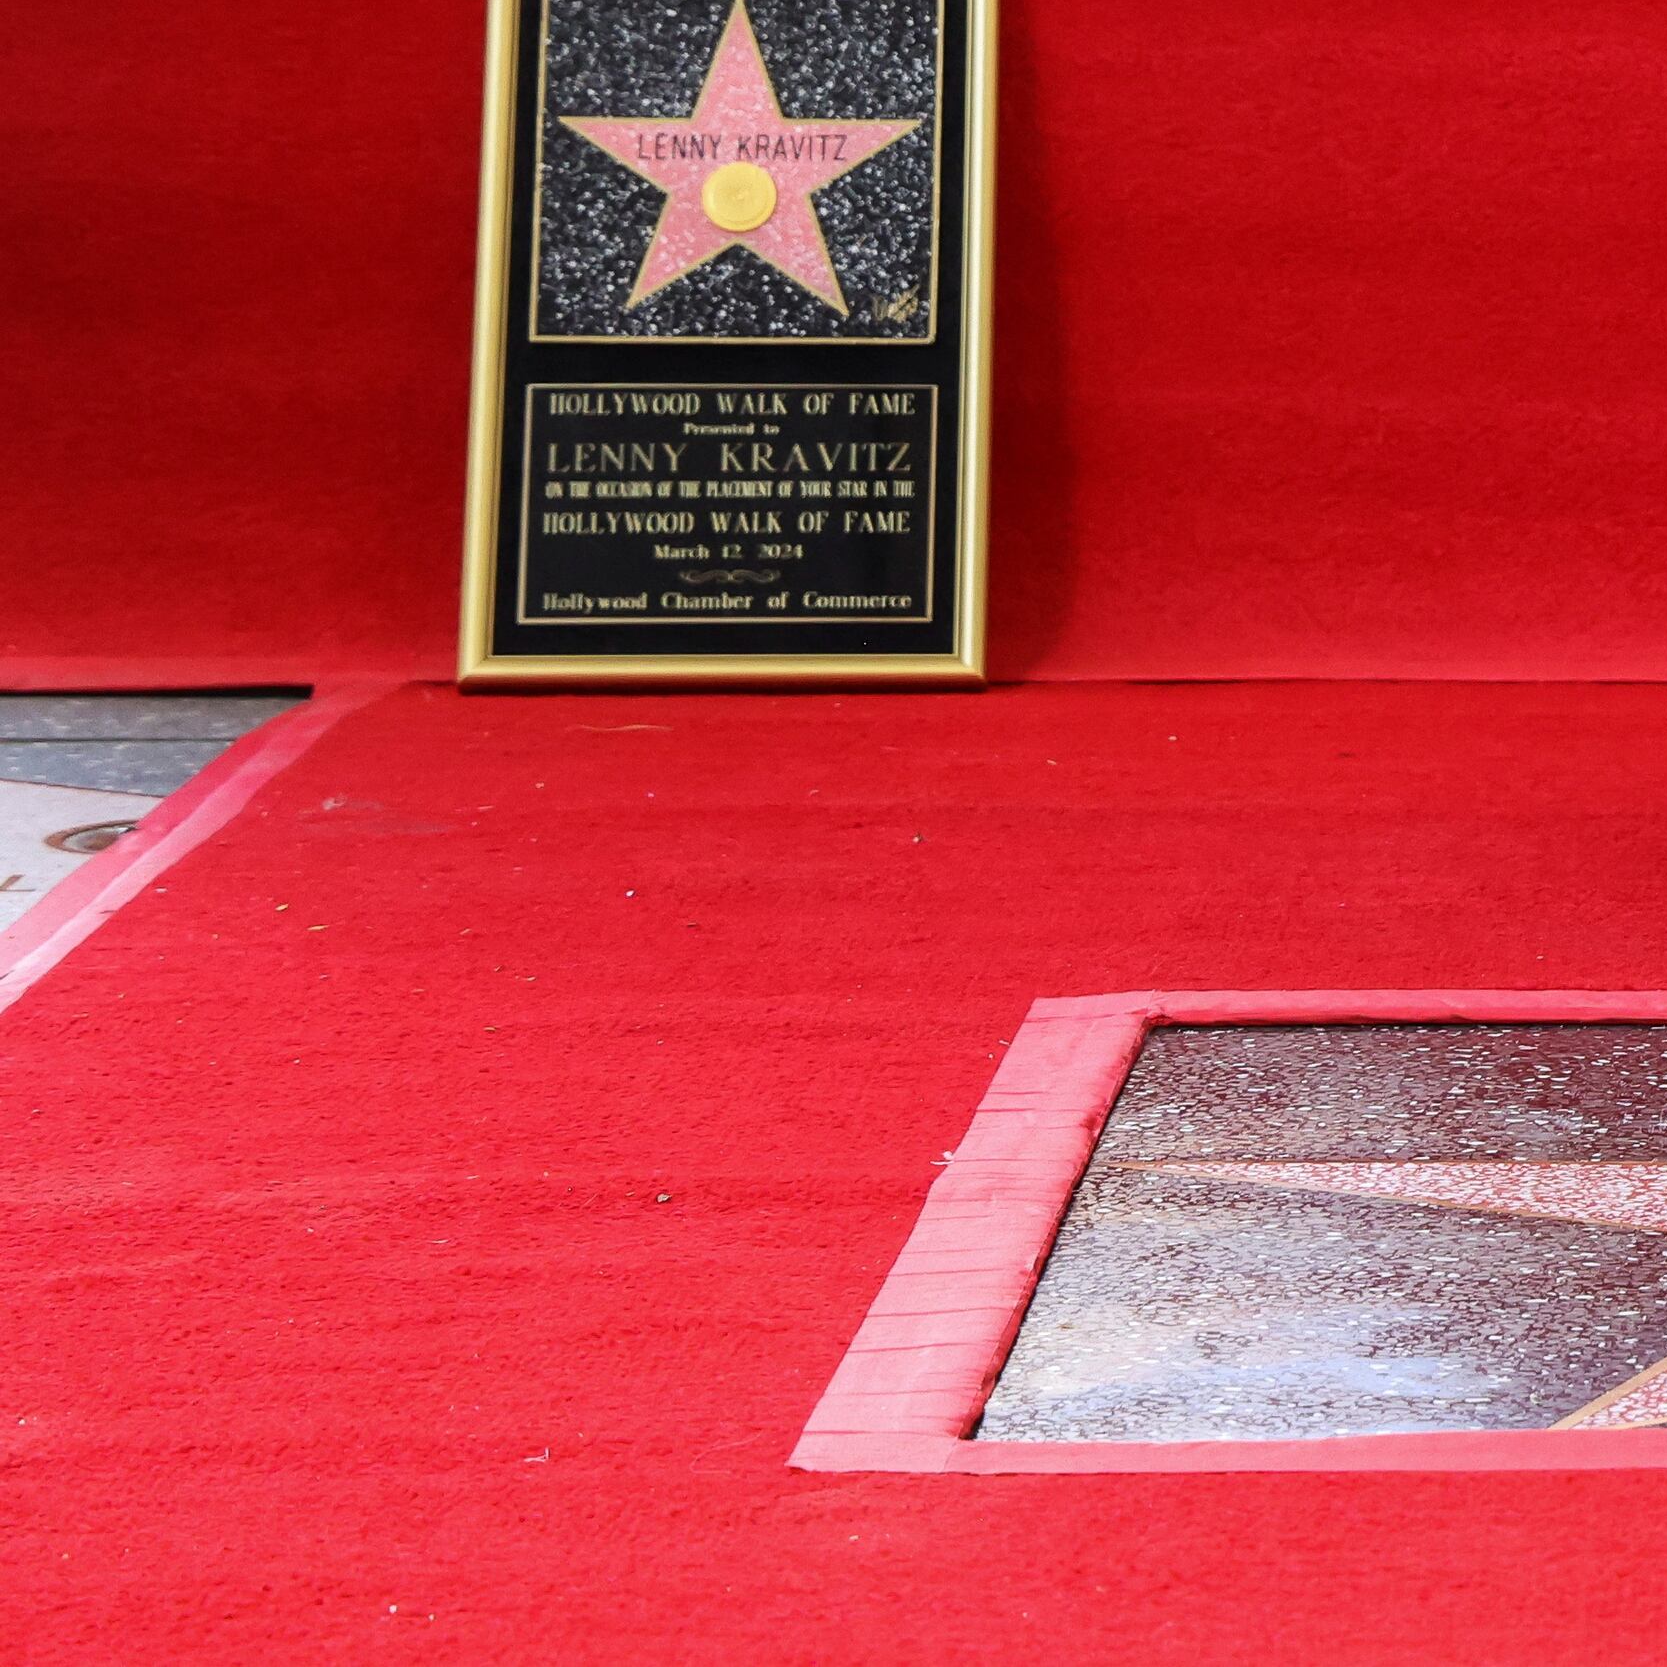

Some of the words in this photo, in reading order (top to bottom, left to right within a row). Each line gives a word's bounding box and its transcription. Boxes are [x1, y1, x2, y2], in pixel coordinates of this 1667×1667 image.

[638, 133, 722, 160] LENNY
[737, 134, 848, 161] KRAVITZ
[550, 392, 701, 416] HOLLYWOOD
[717, 392, 788, 415] WALK
[803, 392, 834, 415] OF
[849, 392, 915, 415] FAME
[763, 423, 780, 435] to
[546, 442, 688, 473] LENNY
[720, 442, 911, 473] KRAVITZ
[543, 511, 695, 535] HOLLYWOOD
[710, 511, 782, 534] WALK
[797, 511, 829, 533] OF
[843, 511, 911, 533] FAME
[654, 544, 710, 559] March
[757, 544, 804, 559] 2024
[543, 592, 648, 613] Hollywood
[661, 591, 754, 610] Chamber
[766, 591, 790, 610] of
[803, 591, 912, 609] Commerce
